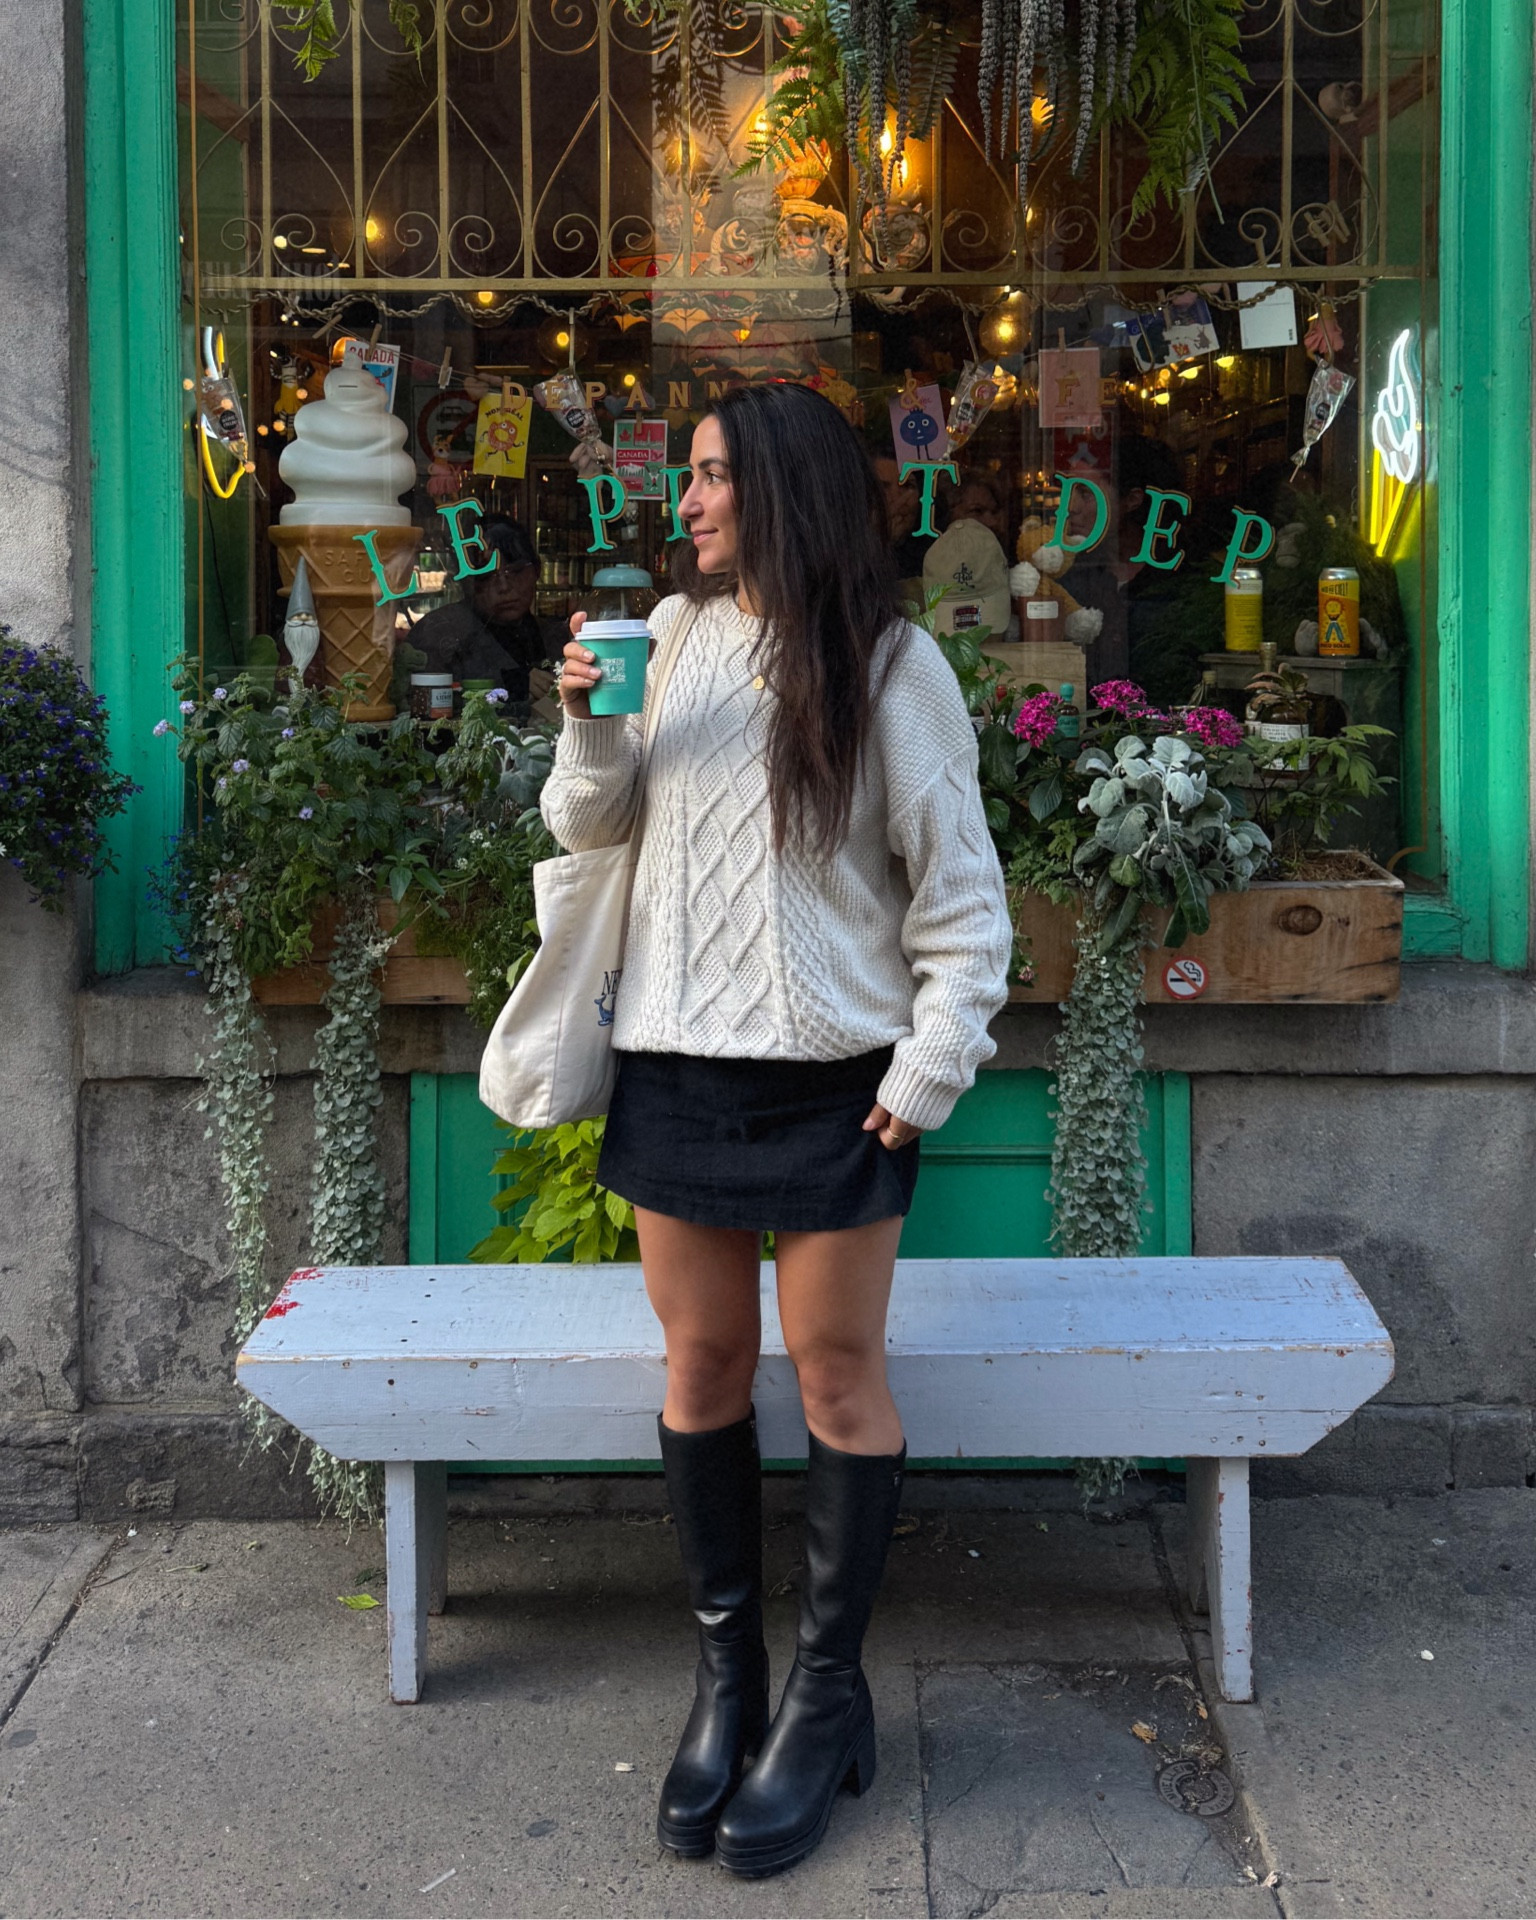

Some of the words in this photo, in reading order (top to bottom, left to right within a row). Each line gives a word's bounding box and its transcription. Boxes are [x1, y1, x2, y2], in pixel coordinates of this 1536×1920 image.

[617, 450, 648, 459] CANADA
[353, 497, 501, 607] LE
[1043, 472, 1276, 588] DEP
